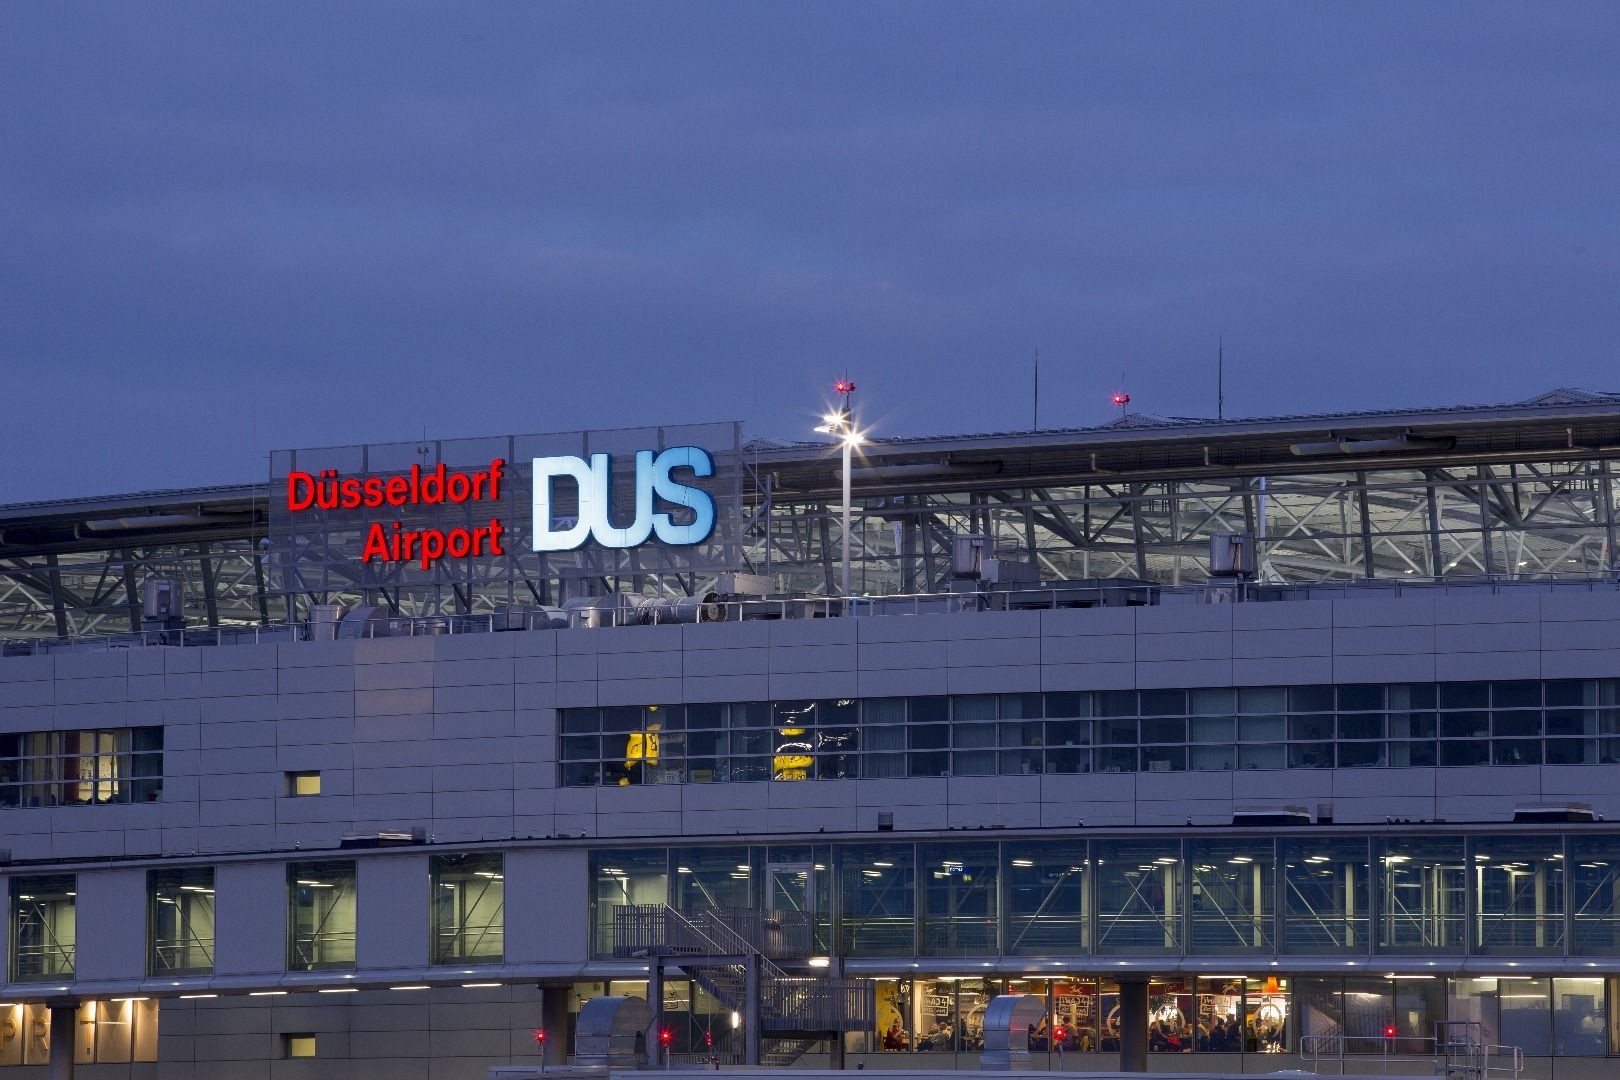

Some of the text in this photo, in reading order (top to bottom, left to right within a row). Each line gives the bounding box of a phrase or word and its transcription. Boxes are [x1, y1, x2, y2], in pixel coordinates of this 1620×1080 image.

[287, 458, 506, 512] Düsseldorf
[531, 445, 716, 552] DUS
[362, 518, 506, 571] Airport
